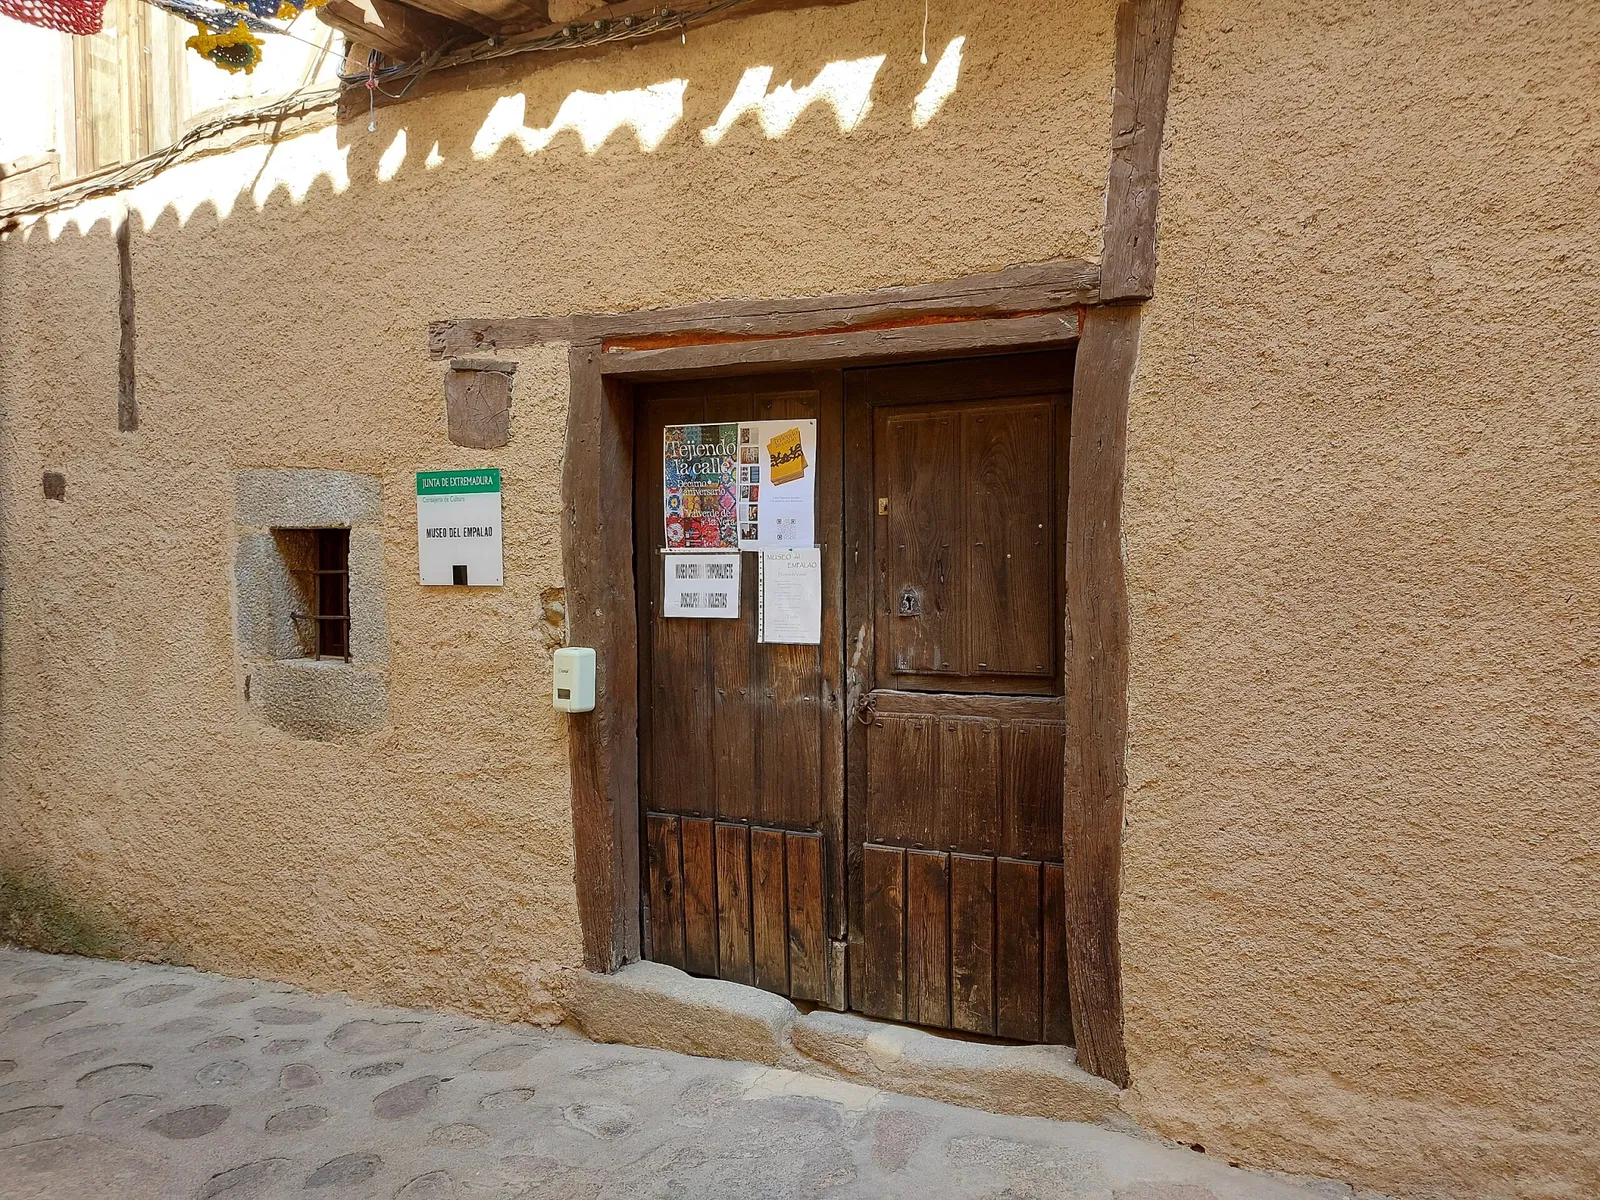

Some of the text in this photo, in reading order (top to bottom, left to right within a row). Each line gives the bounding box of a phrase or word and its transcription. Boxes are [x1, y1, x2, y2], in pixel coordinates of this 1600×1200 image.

[666, 439, 736, 461] Tejiendo
[674, 457, 730, 475] la calle
[422, 475, 493, 489] JUNTA DE EXTREMADURA
[683, 488, 726, 496] aniversario
[720, 508, 731, 517] de
[426, 526, 493, 538] MUSEO DEL EMPALAO
[766, 553, 792, 561] MUSEO
[675, 563, 688, 579] MUSEO
[787, 561, 818, 569] EMPALAO
